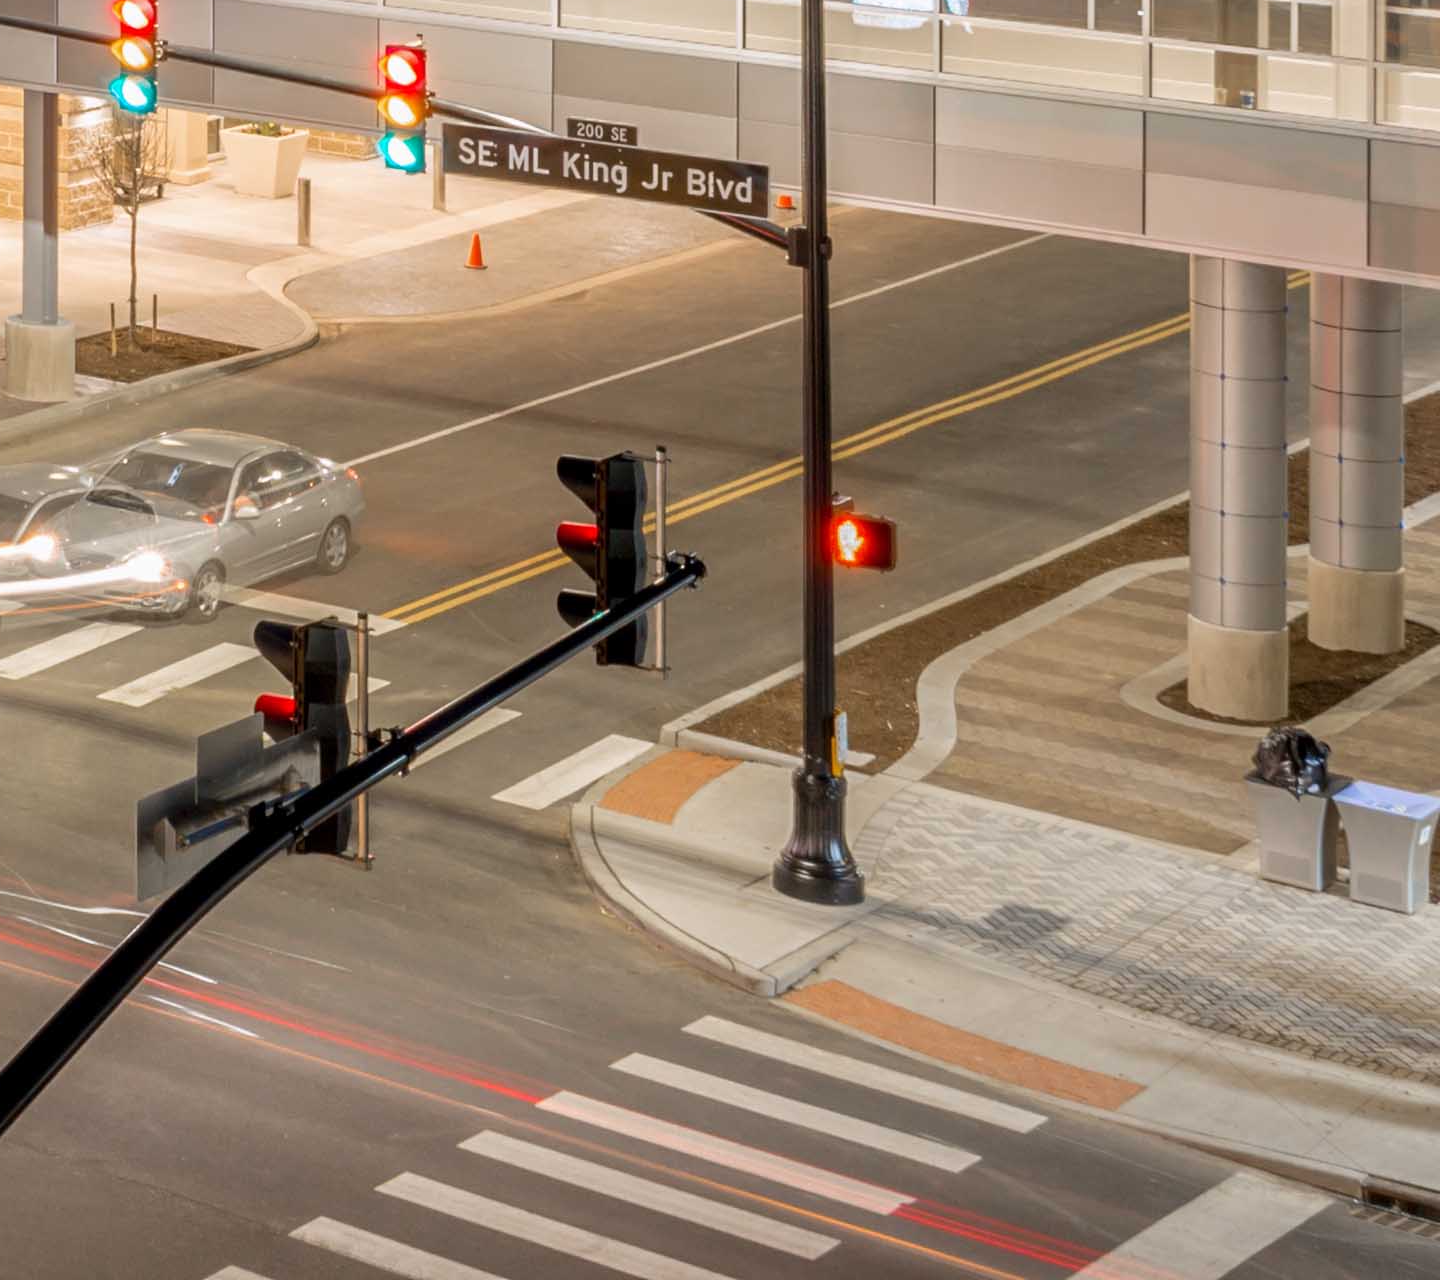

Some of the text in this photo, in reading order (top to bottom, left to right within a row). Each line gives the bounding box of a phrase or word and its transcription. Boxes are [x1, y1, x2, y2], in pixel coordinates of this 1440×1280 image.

[576, 122, 628, 143] 200 SE
[457, 137, 753, 204] SE ML King Jr Blvd
